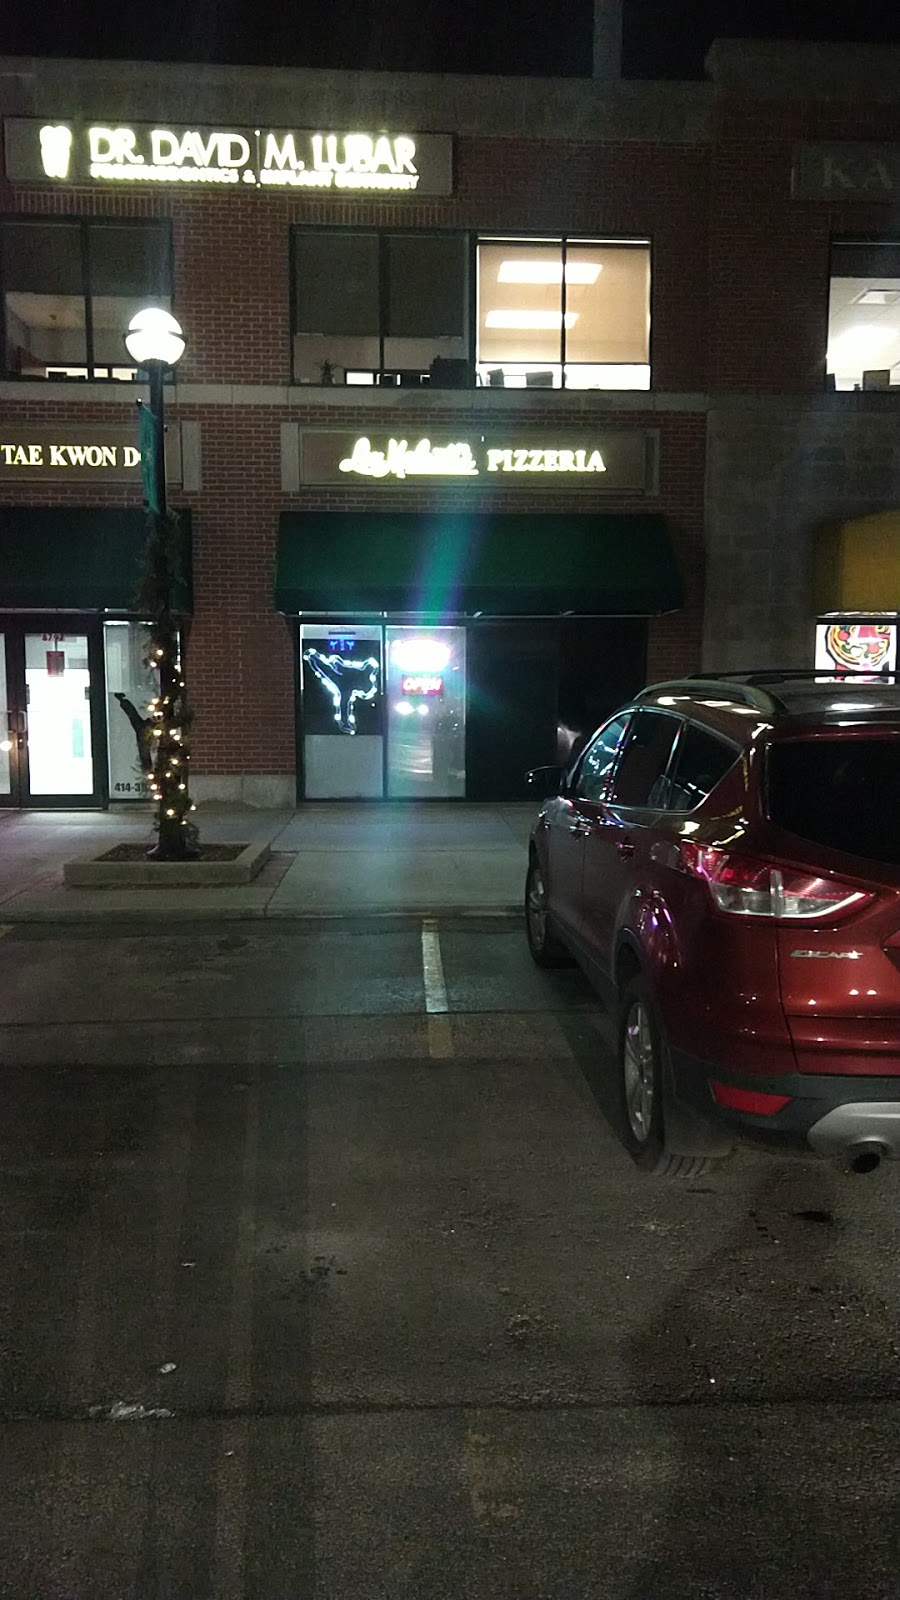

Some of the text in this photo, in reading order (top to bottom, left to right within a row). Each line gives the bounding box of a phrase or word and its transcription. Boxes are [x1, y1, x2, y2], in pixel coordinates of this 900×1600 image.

[88, 127, 417, 173] DR. DAVID M. LUBAR
[1, 445, 141, 467] TAE KWON D
[487, 449, 606, 472] PIZZERIA
